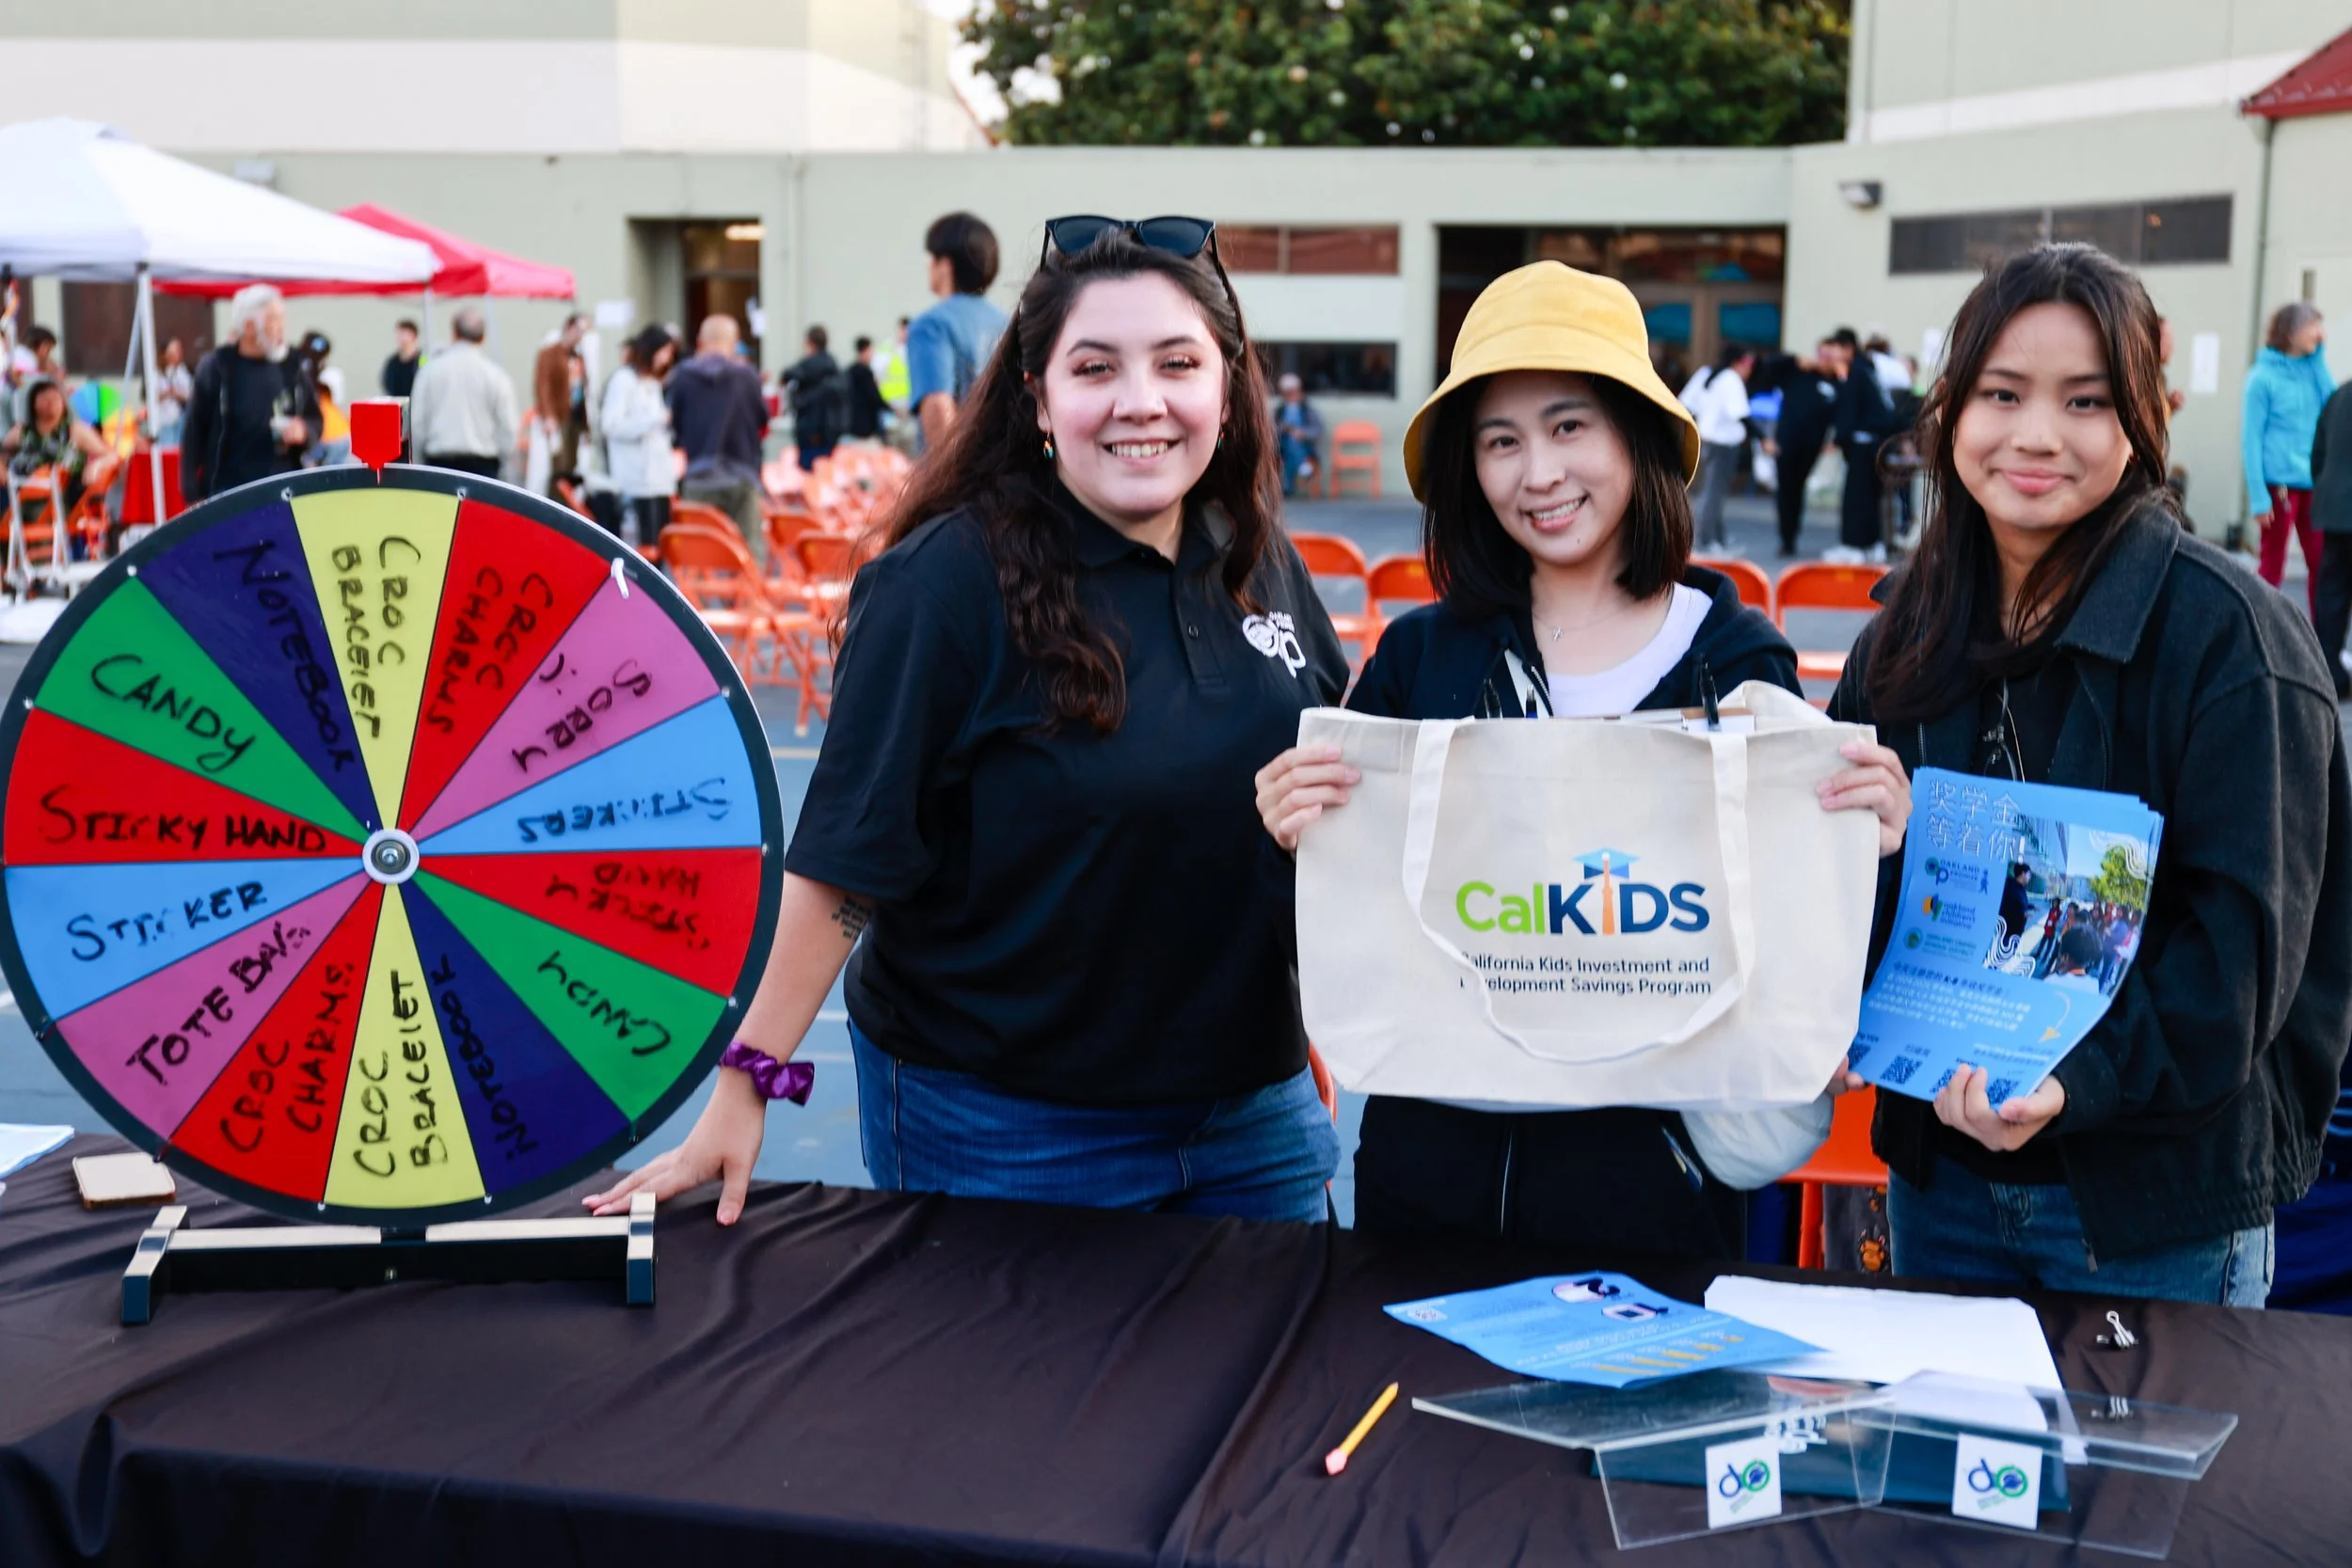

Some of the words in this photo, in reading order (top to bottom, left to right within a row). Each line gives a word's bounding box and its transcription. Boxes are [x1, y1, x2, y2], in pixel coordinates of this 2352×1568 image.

[215, 540, 356, 772] NOTEBOOK
[379, 535, 421, 666] CROC
[426, 567, 504, 734] CHARMS
[90, 653, 259, 773] CANDY
[511, 660, 653, 773] SORRY
[39, 785, 208, 851] STICKY
[226, 817, 327, 853] HAND
[537, 950, 673, 1059] CANDY
[1539, 954, 1573, 973] Kids
[1578, 957, 1673, 974] Investment
[1678, 957, 1710, 974] and
[1571, 977, 1634, 997] Savings
[1639, 978, 1712, 997] Program
[126, 986, 233, 1087] TOTE
[431, 952, 540, 1161] NOTEBOOK
[219, 1038, 293, 1154] CROC
[354, 1052, 398, 1179] CROC
